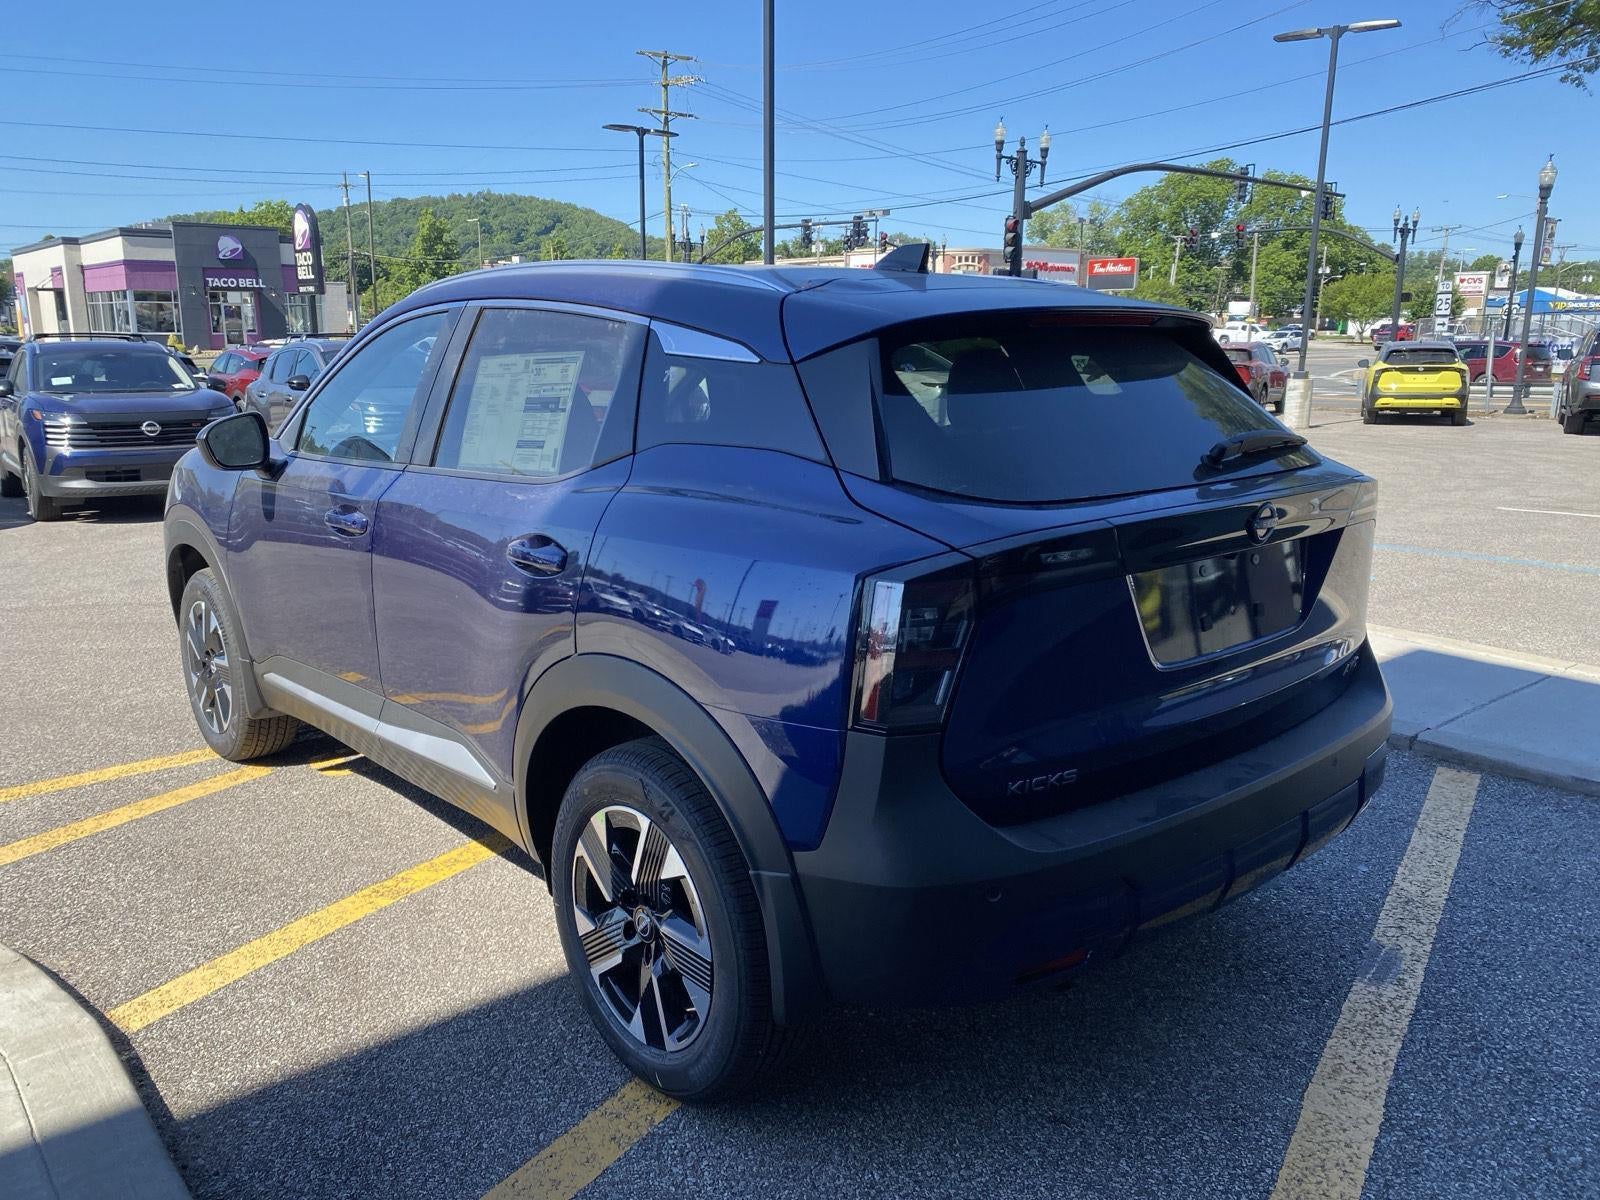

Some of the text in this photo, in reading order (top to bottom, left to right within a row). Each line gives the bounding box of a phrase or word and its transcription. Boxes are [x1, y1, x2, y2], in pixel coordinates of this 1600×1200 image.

[295, 252, 312, 266] TACO
[297, 266, 314, 279] BELL
[1093, 262, 1132, 273] Tim Hortons
[206, 278, 266, 288] TACO BELL
[1437, 298, 1450, 310] 25
[1549, 301, 1566, 310] VIP
[1007, 768, 1078, 796] KICKS
